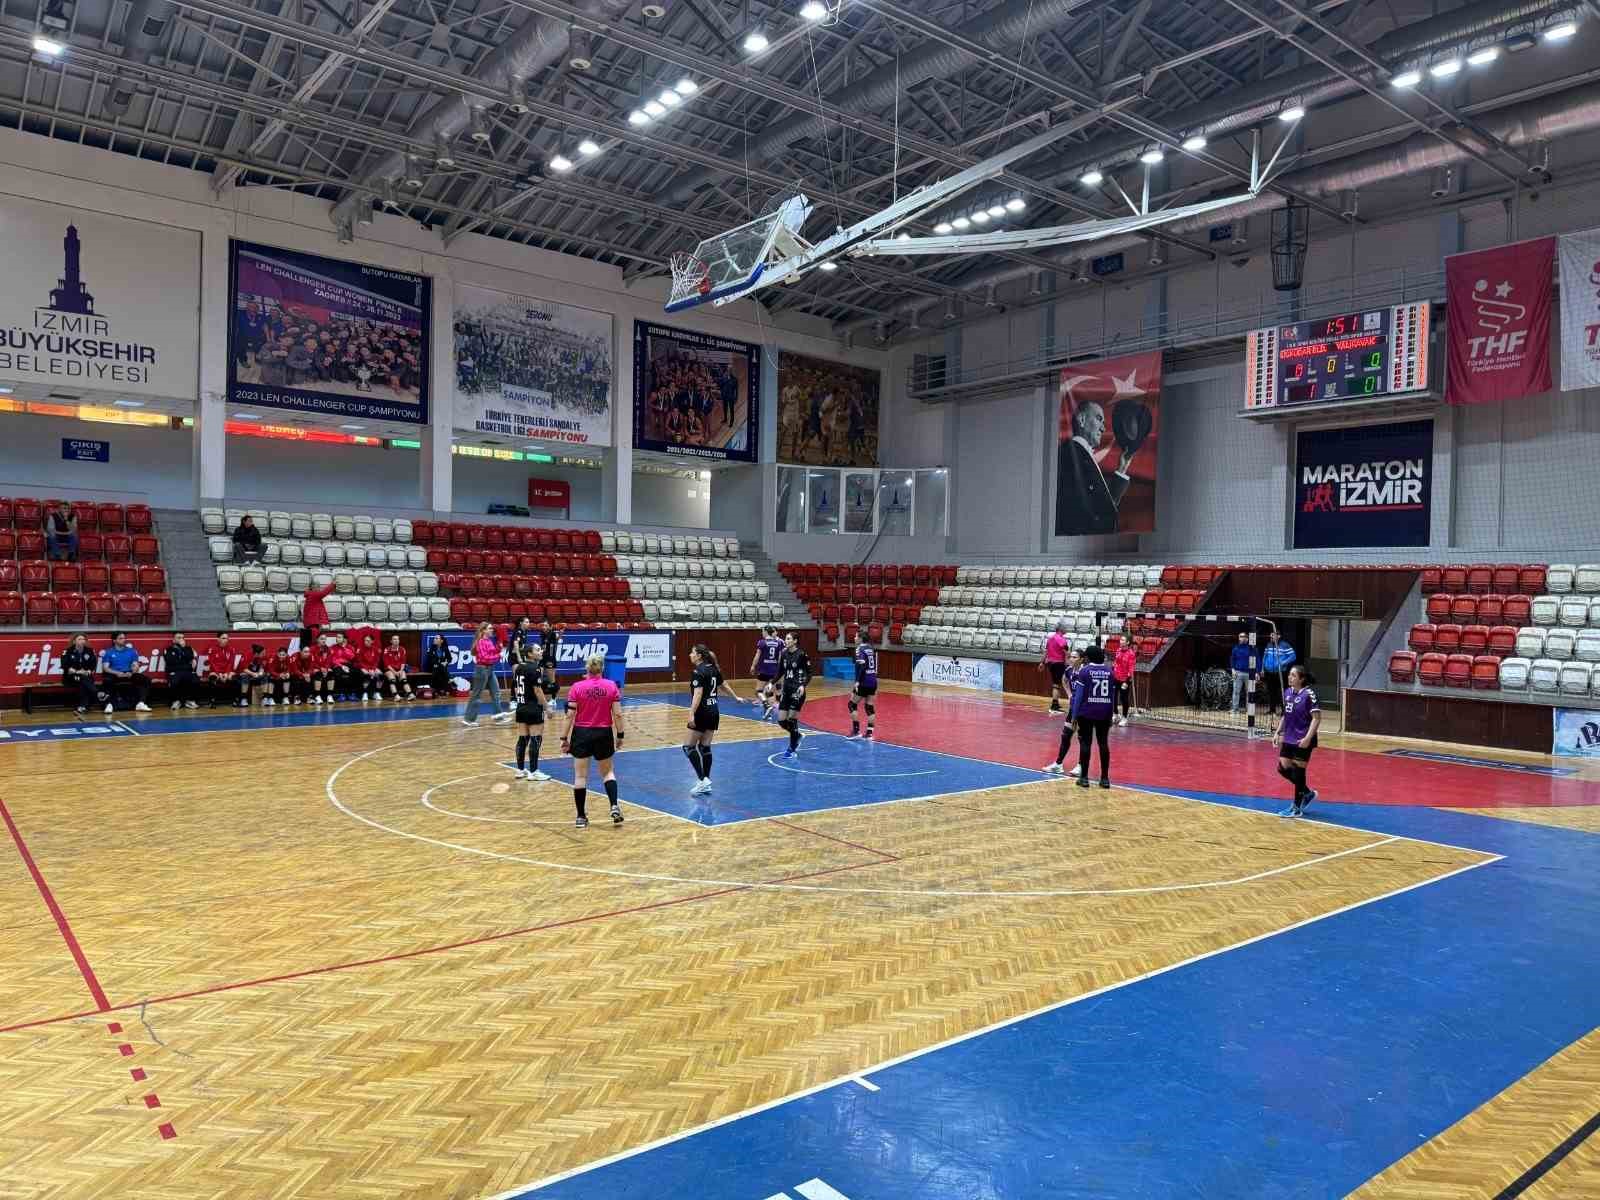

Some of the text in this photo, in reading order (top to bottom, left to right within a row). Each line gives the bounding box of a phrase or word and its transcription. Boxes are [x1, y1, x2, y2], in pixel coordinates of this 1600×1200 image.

[1467, 329, 1529, 359] THF
[235, 390, 259, 400] 2023
[260, 391, 280, 403] LEN
[282, 393, 346, 411] CHALLENGER
[347, 402, 367, 413] CUP
[1303, 458, 1424, 485] MARATON
[516, 674, 525, 695] 15
[709, 676, 717, 698] 2
[1091, 678, 1109, 698] 78
